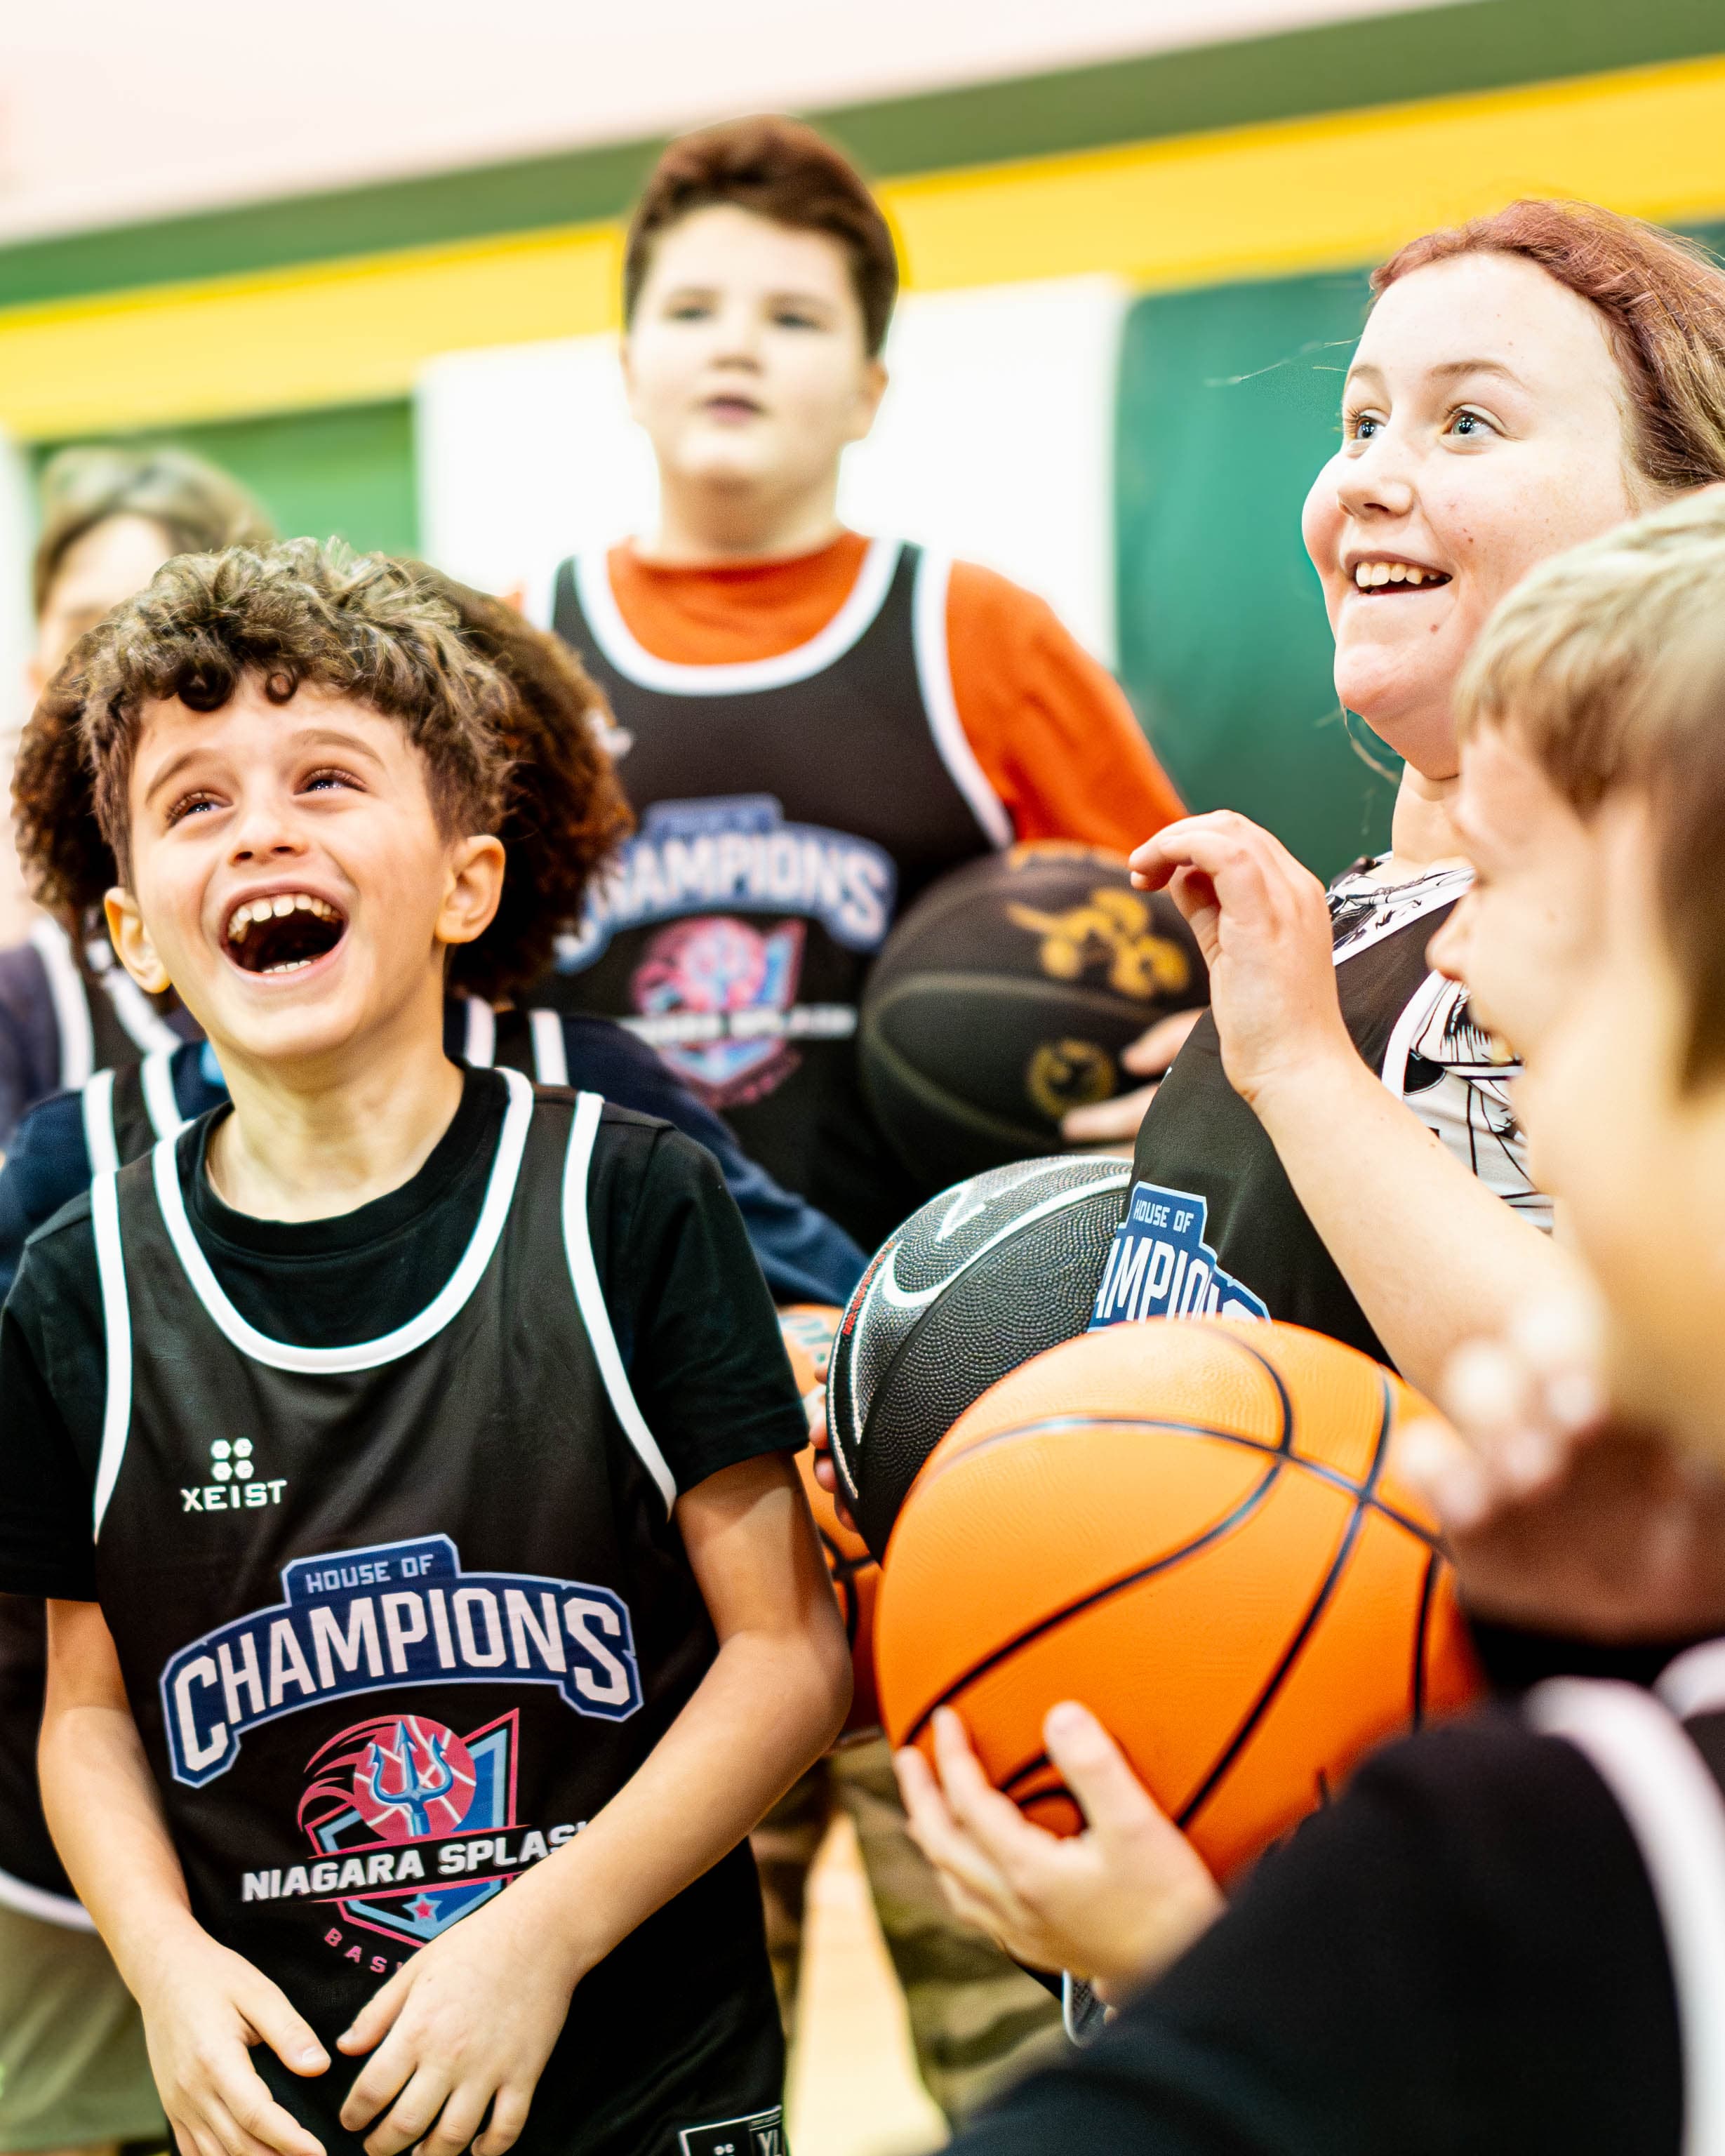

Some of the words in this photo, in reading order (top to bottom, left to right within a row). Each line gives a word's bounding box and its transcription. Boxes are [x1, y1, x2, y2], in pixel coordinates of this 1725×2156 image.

[1133, 1199, 1171, 1228] HOUSE
[1173, 1210, 1194, 1233] OF
[180, 1479, 288, 1512] XEIST
[305, 1561, 392, 1594] HOUSE
[400, 1553, 434, 1578] OF
[174, 1588, 631, 1772] CHAMPIONS
[241, 1849, 425, 1903] NIAGARA
[437, 1821, 587, 1874] SPLAS
[324, 1927, 403, 1974] BAS
